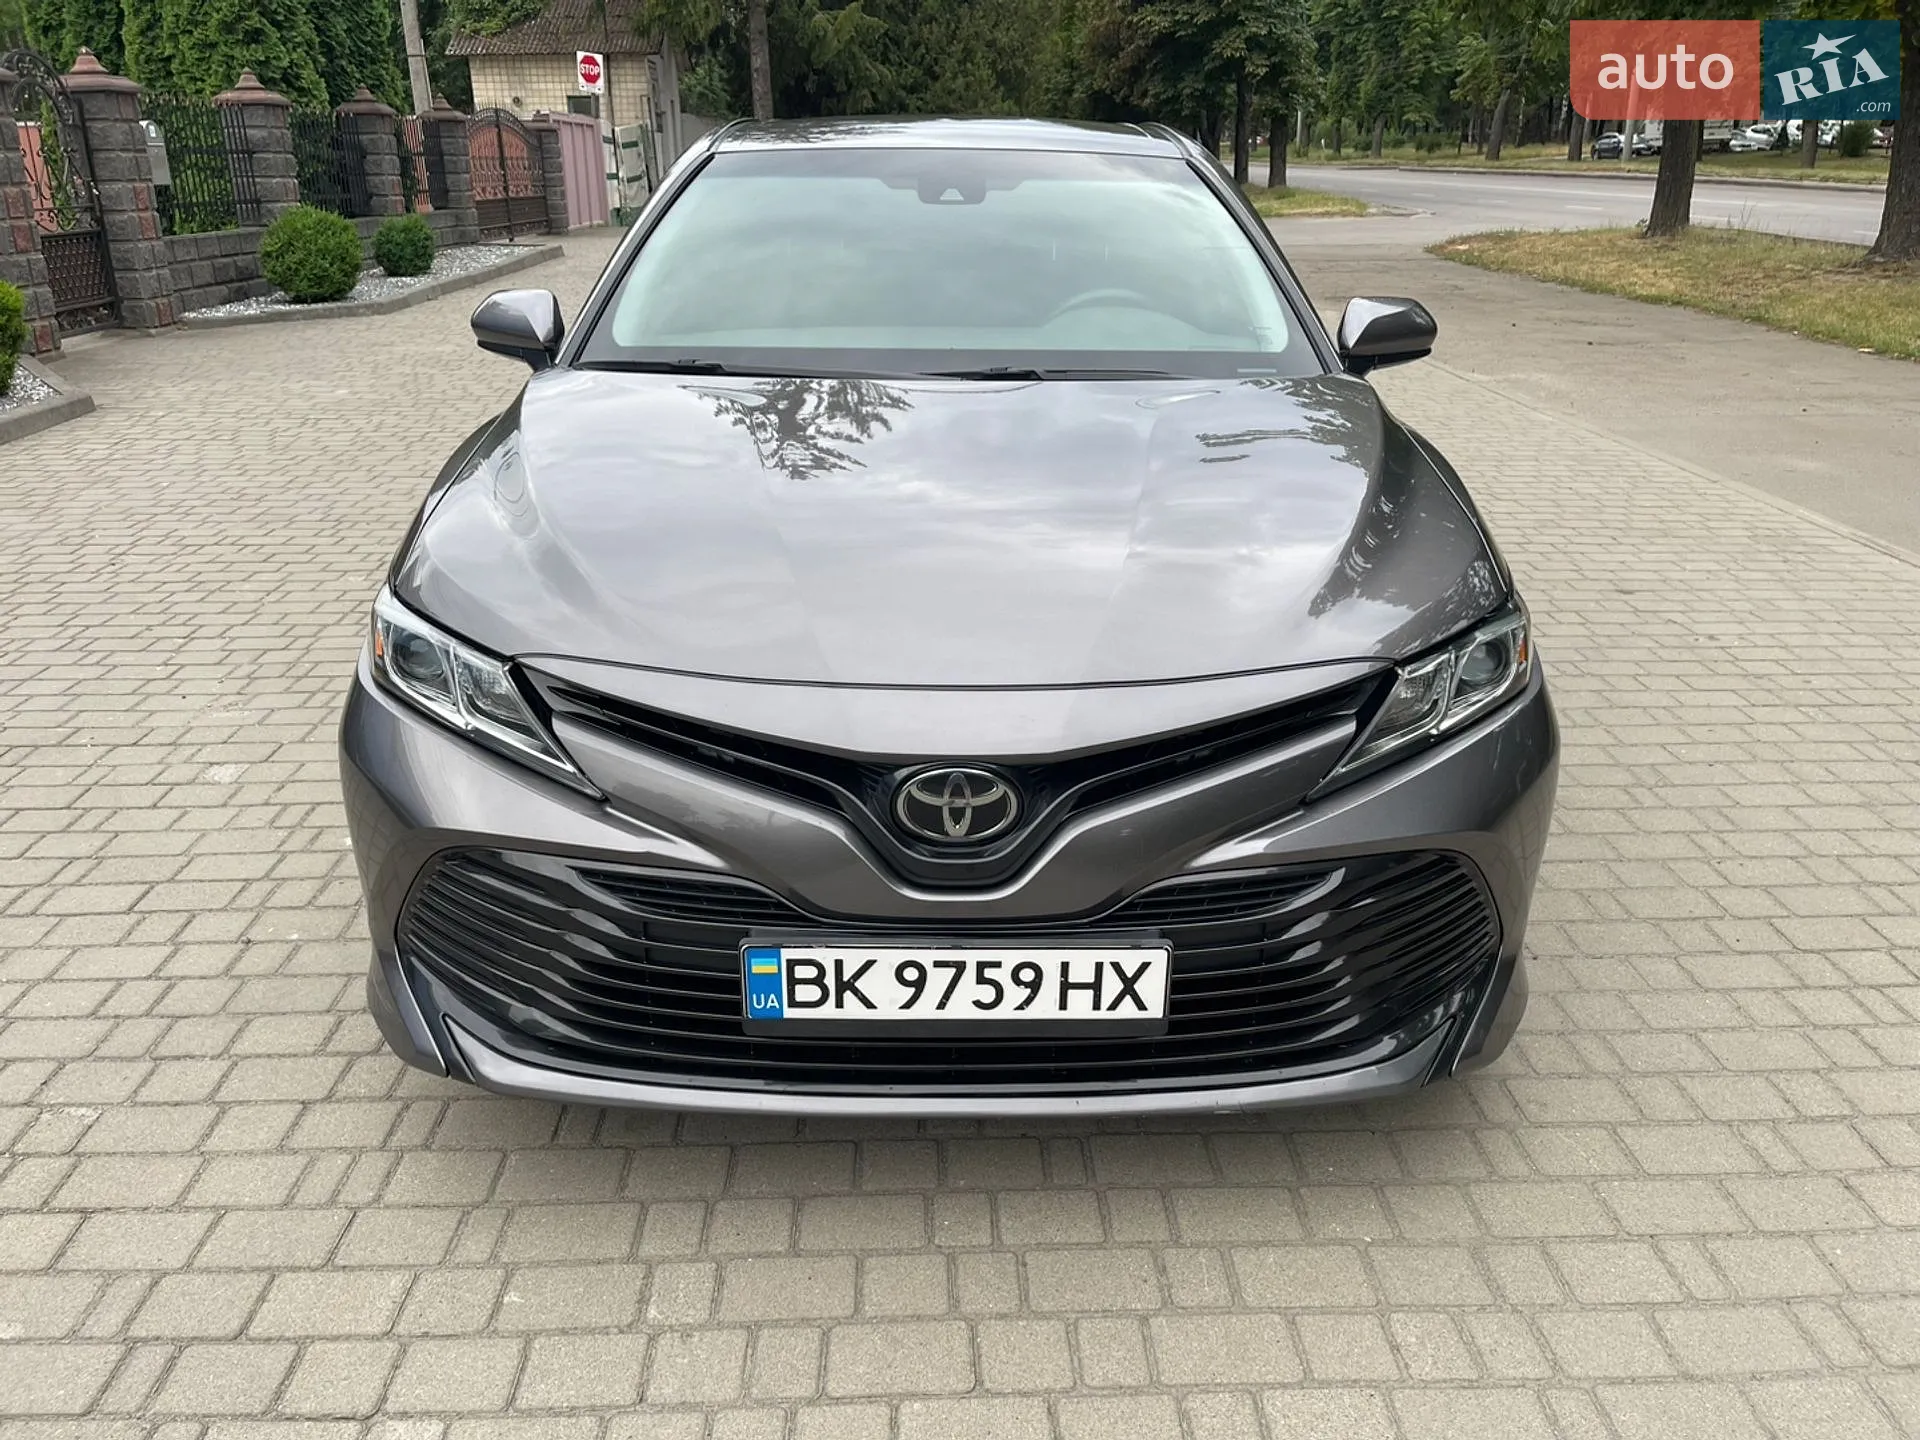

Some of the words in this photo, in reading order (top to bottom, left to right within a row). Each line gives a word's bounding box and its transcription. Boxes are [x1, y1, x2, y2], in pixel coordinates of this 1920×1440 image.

[580, 63, 600, 76] STOP
[786, 958, 878, 1010] BK
[894, 960, 1044, 1011] 9759
[1057, 961, 1152, 1012] HX
[753, 993, 780, 1010] UA
